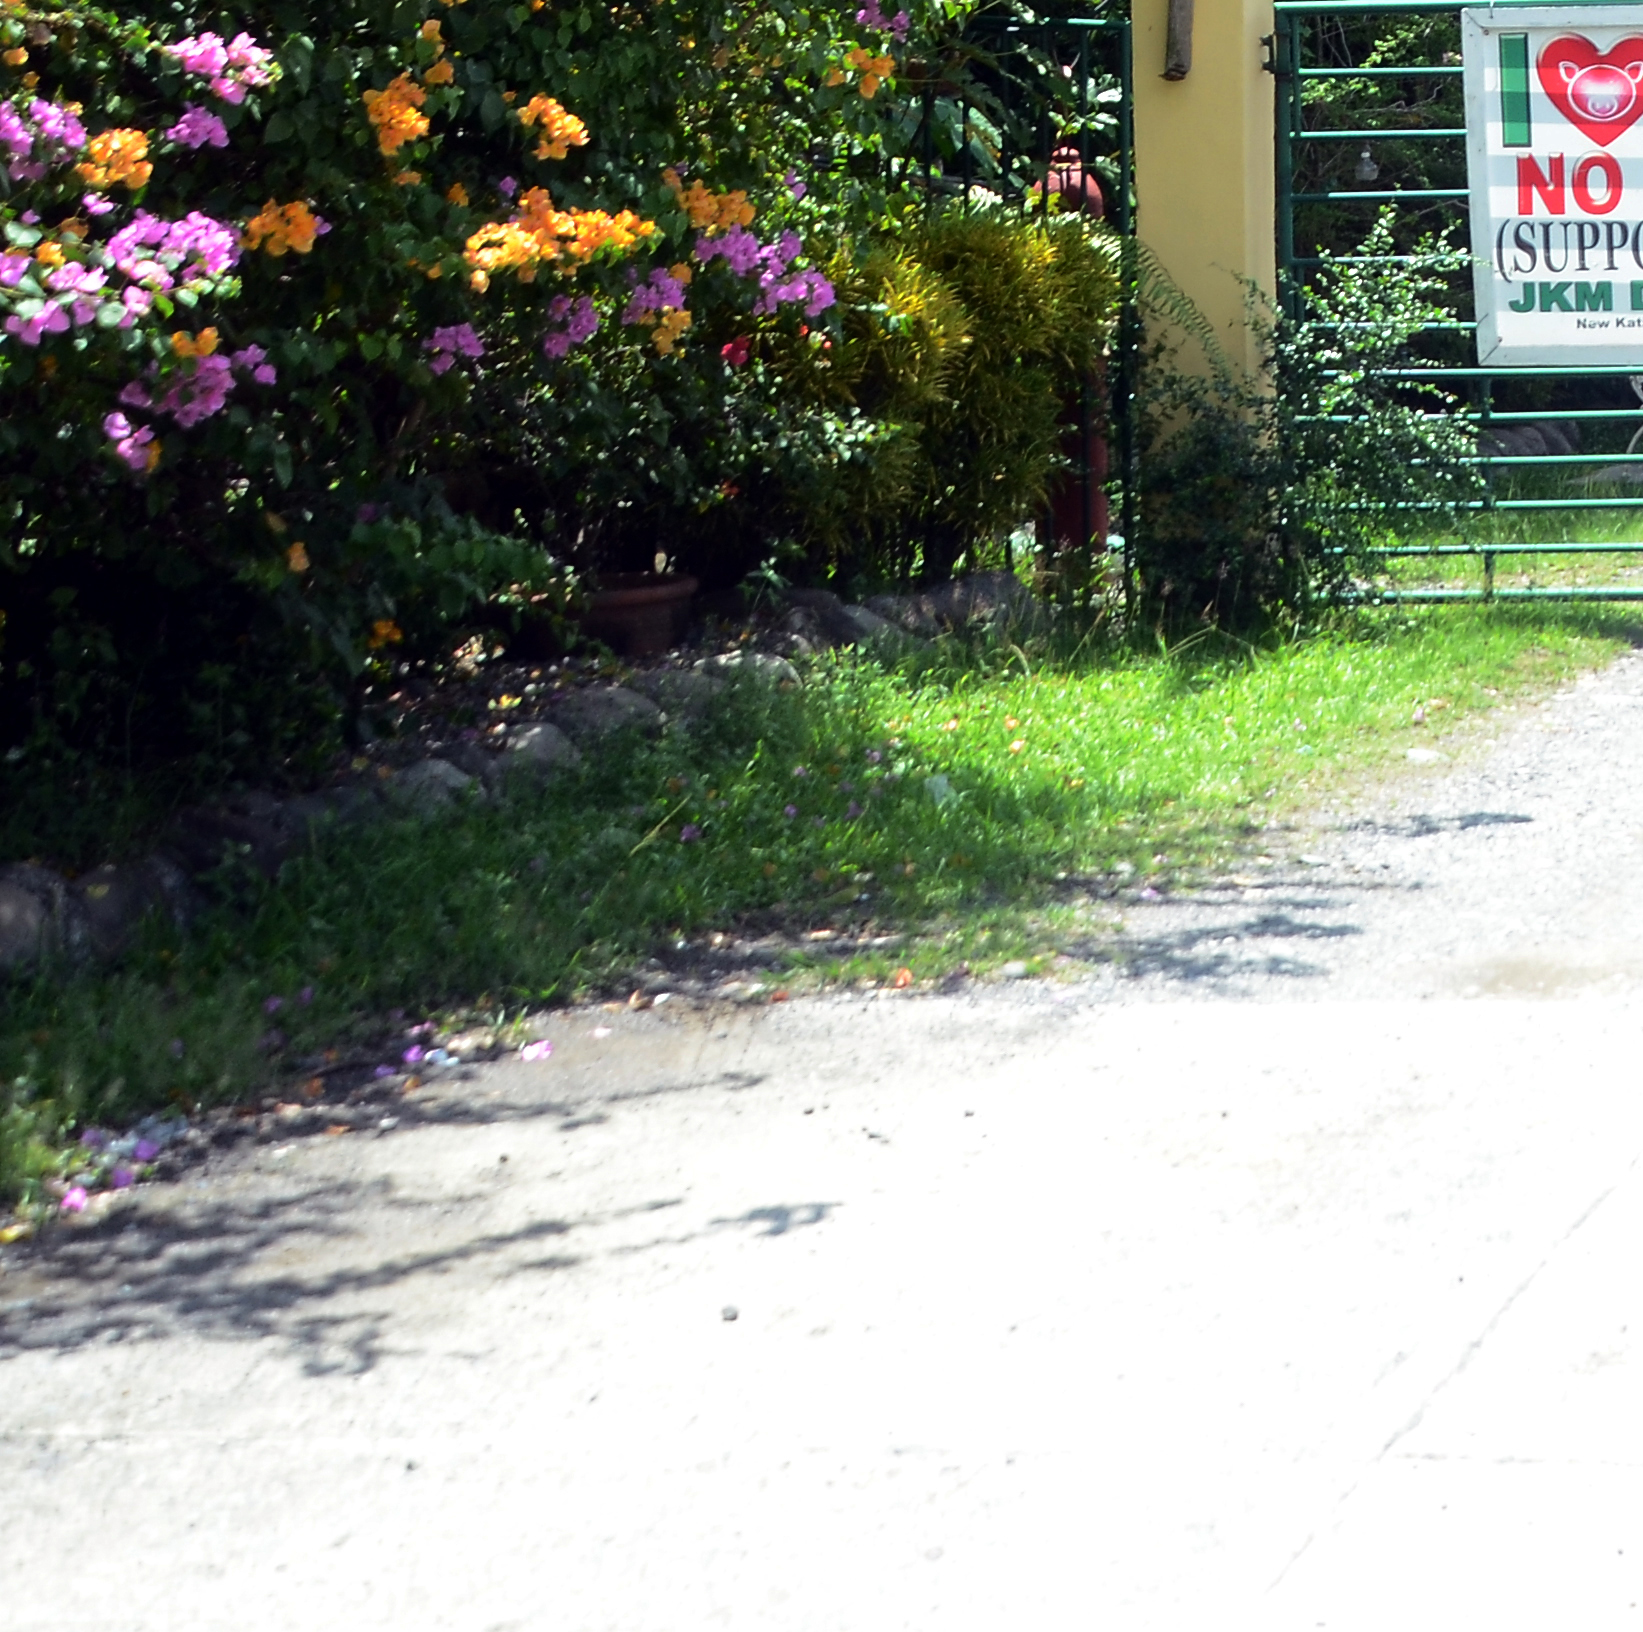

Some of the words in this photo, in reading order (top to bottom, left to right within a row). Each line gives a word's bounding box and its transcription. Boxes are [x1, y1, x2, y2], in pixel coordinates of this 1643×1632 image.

[1498, 32, 1532, 148] I
[1516, 150, 1623, 216] NO
[1508, 280, 1613, 313] JKM
[1576, 318, 1609, 329] New
